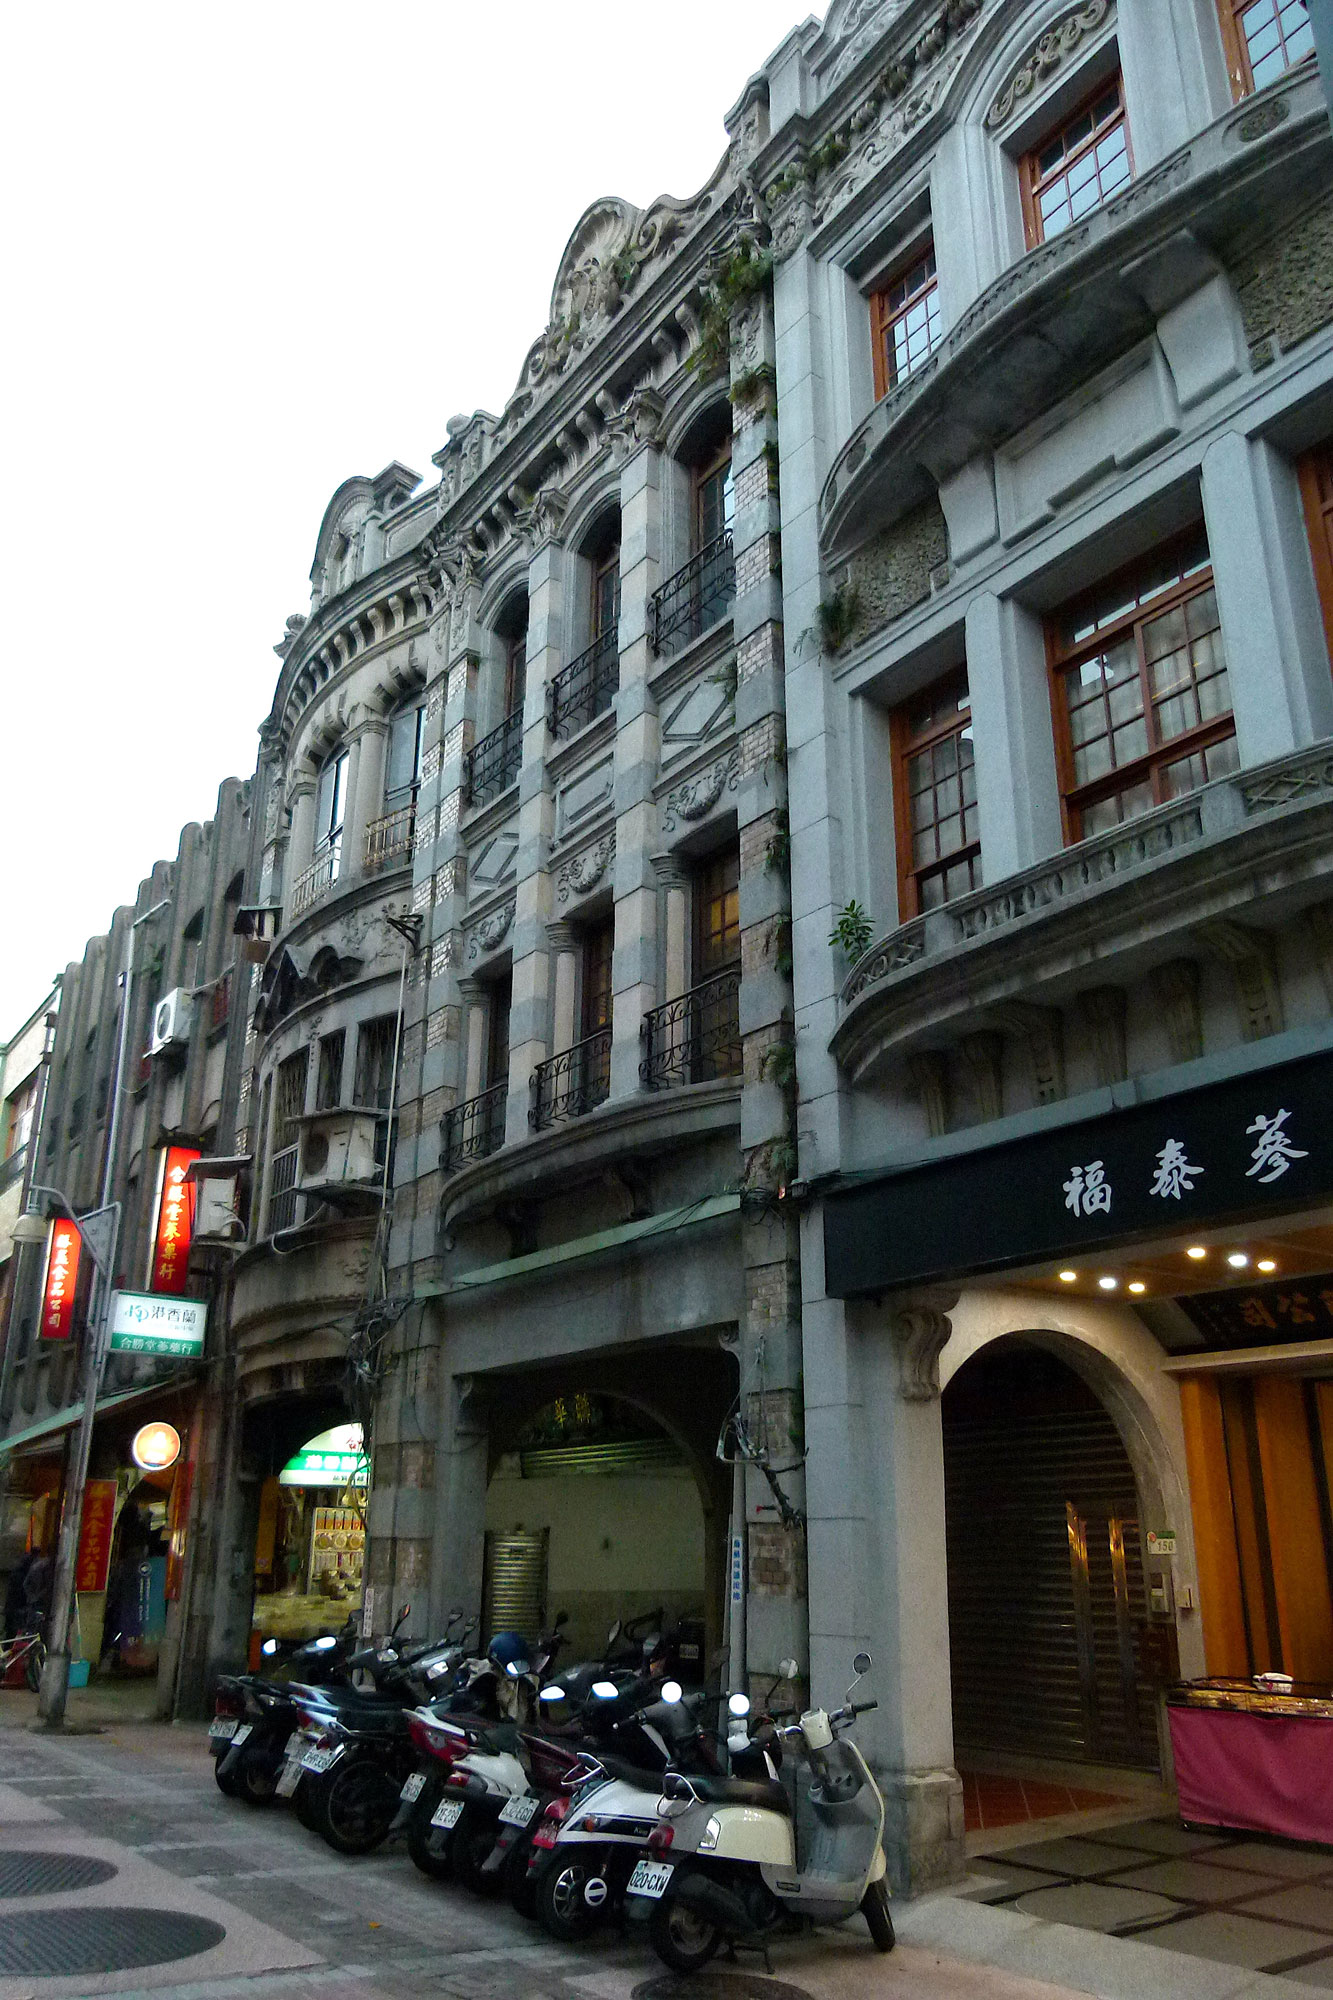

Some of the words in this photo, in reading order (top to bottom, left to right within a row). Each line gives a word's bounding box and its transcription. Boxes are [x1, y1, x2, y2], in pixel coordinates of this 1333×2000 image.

[1062, 1107, 1309, 1218] 福泰蔘
[151, 1304, 197, 1325] 港香蘭
[1157, 1540, 1173, 1551] 150
[629, 1870, 670, 1893] 020-CXW
